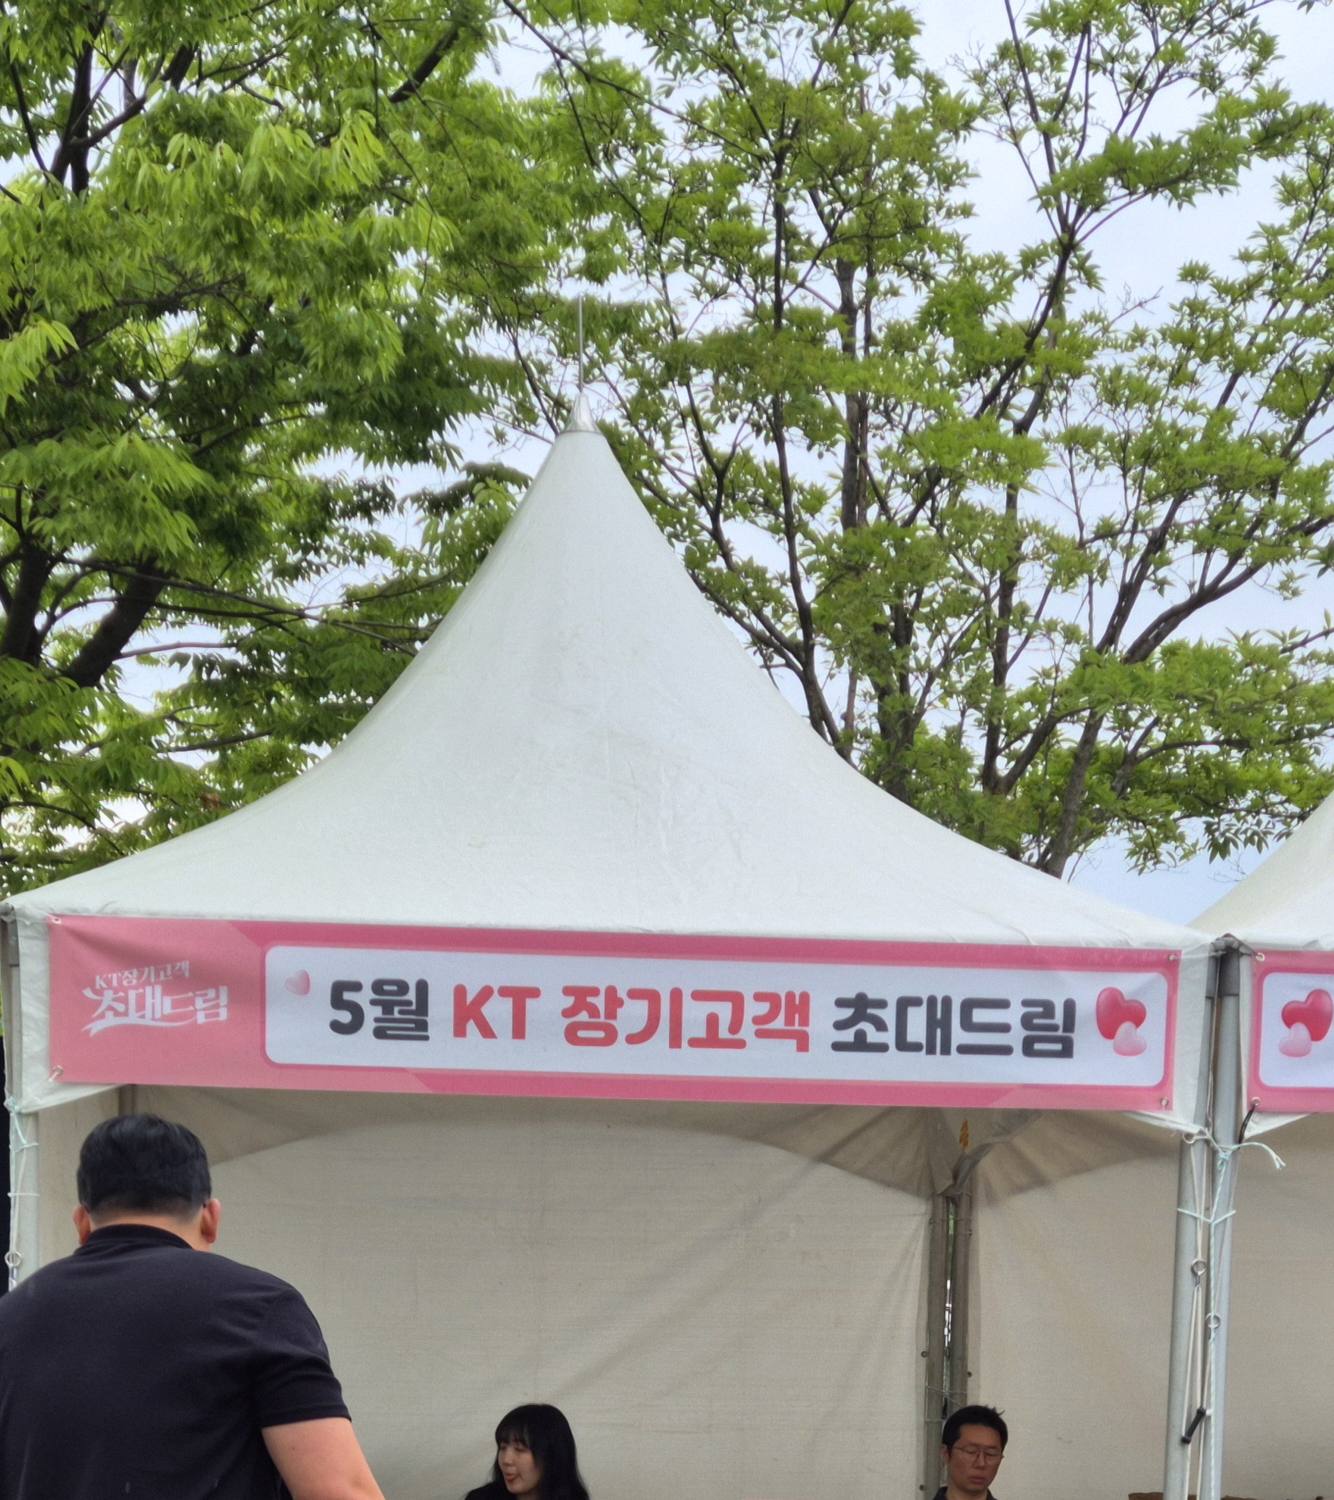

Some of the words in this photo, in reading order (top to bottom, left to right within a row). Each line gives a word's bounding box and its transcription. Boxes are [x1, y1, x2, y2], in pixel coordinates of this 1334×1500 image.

[95, 960, 190, 989] KT장기고객
[81, 985, 229, 1038] 초대드림
[329, 978, 430, 1041] 5월
[453, 984, 542, 1040] KT
[560, 984, 811, 1053] 장기고객
[830, 991, 1077, 1059] 초대드림
